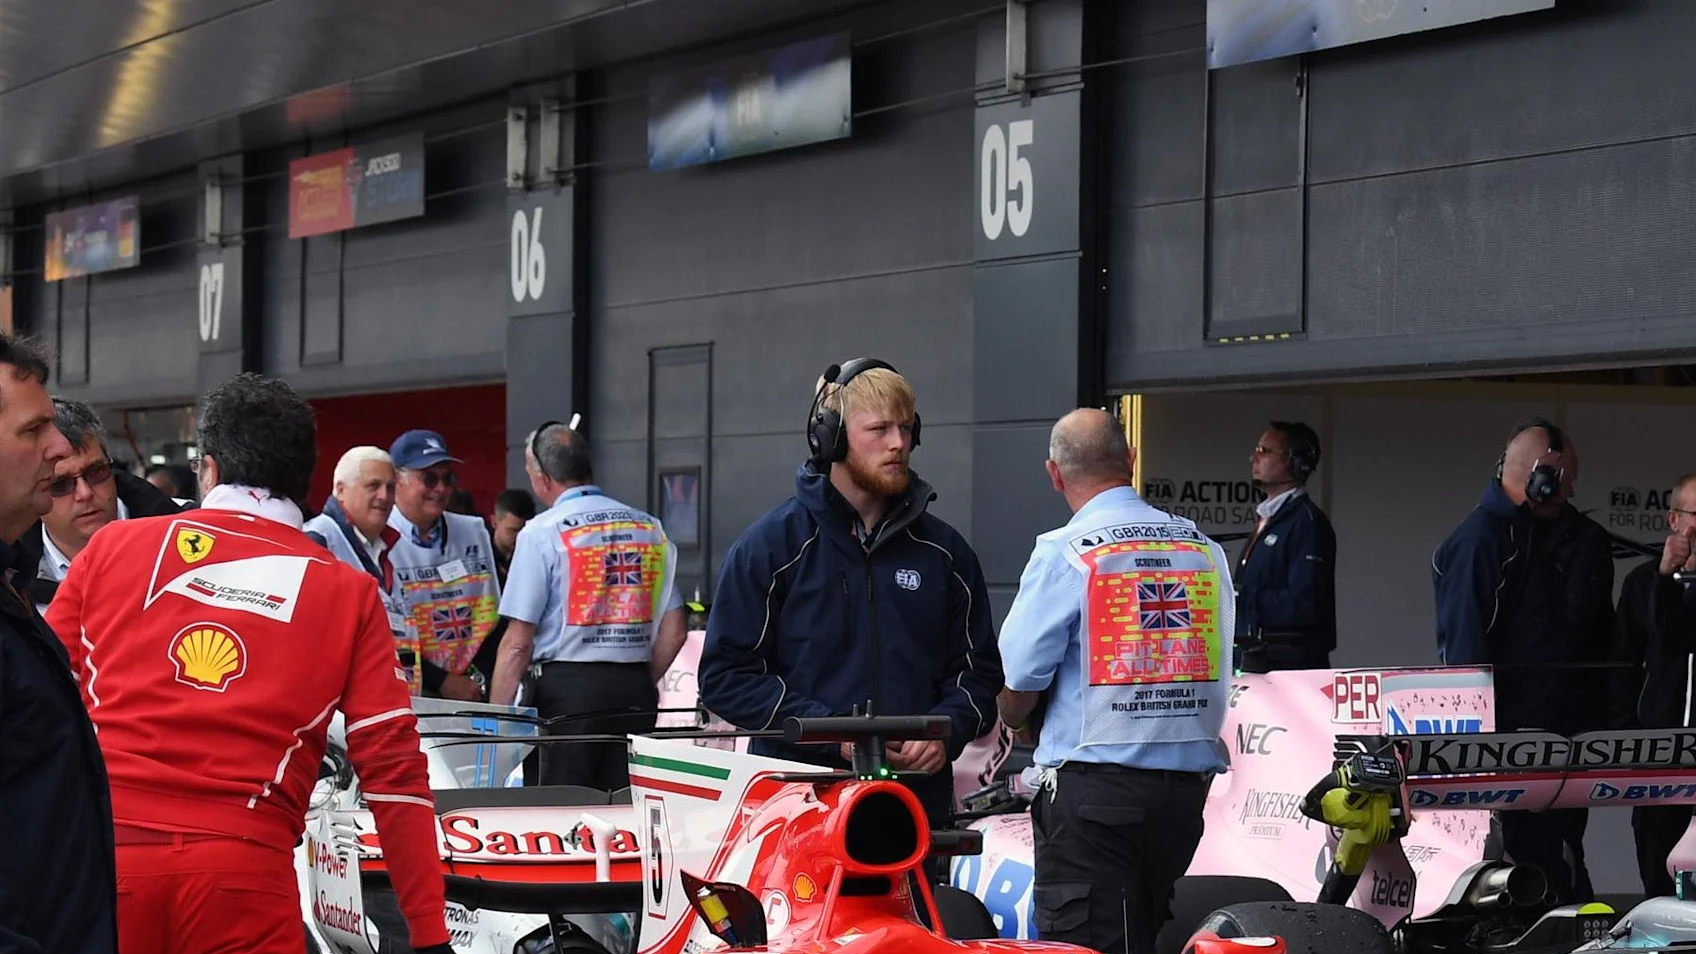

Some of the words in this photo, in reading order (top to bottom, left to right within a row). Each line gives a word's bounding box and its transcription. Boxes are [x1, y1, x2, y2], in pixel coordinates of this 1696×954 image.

[980, 119, 1034, 241] 05
[511, 207, 545, 302] 06
[200, 262, 223, 342] 07
[1611, 492, 1637, 507] FIA
[191, 577, 267, 599] SCUDERIA
[896, 570, 920, 589] FIA
[216, 593, 281, 611] FERRARI
[1115, 641, 1153, 659] PIT
[1158, 638, 1207, 657] LANE
[661, 669, 694, 692] EC
[1135, 690, 1152, 700] 2017
[1155, 689, 1189, 699] FORMULA
[1334, 675, 1381, 720] PER
[1112, 702, 1139, 712] ROLEX
[1140, 701, 1172, 711] BRITISH
[1236, 723, 1288, 755] NEC
[1440, 789, 1526, 806] BWT
[442, 815, 641, 855] Santa
[649, 807, 663, 907] 5
[1371, 869, 1412, 908] telcel
[319, 889, 362, 937] Santander
[443, 904, 479, 926] TRONAS
[447, 927, 477, 949] MAX
